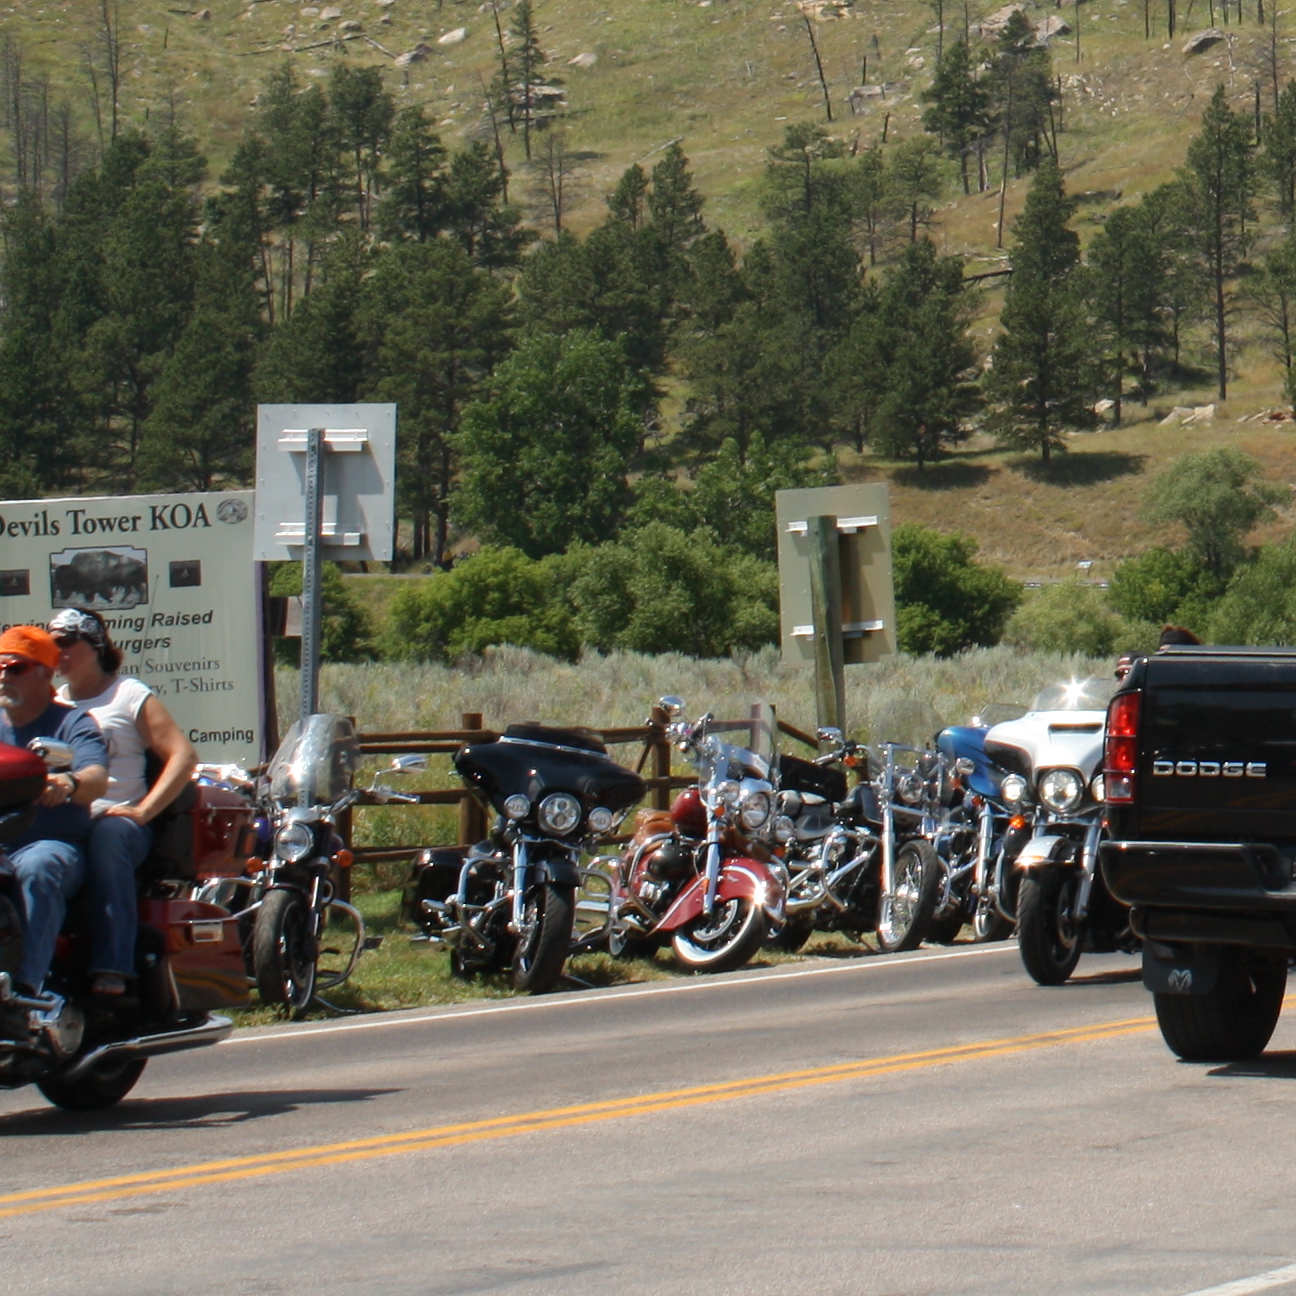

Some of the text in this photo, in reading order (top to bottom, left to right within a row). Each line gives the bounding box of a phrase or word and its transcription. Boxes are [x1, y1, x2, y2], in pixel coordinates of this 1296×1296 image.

[0, 502, 212, 537] evils Tower KOA
[151, 610, 214, 628] Raised
[113, 636, 171, 654] urgers
[145, 656, 221, 674] Souvenirs
[171, 677, 234, 693] T-Shirts
[189, 727, 254, 745] Camping
[1153, 760, 1267, 777] DODGE
